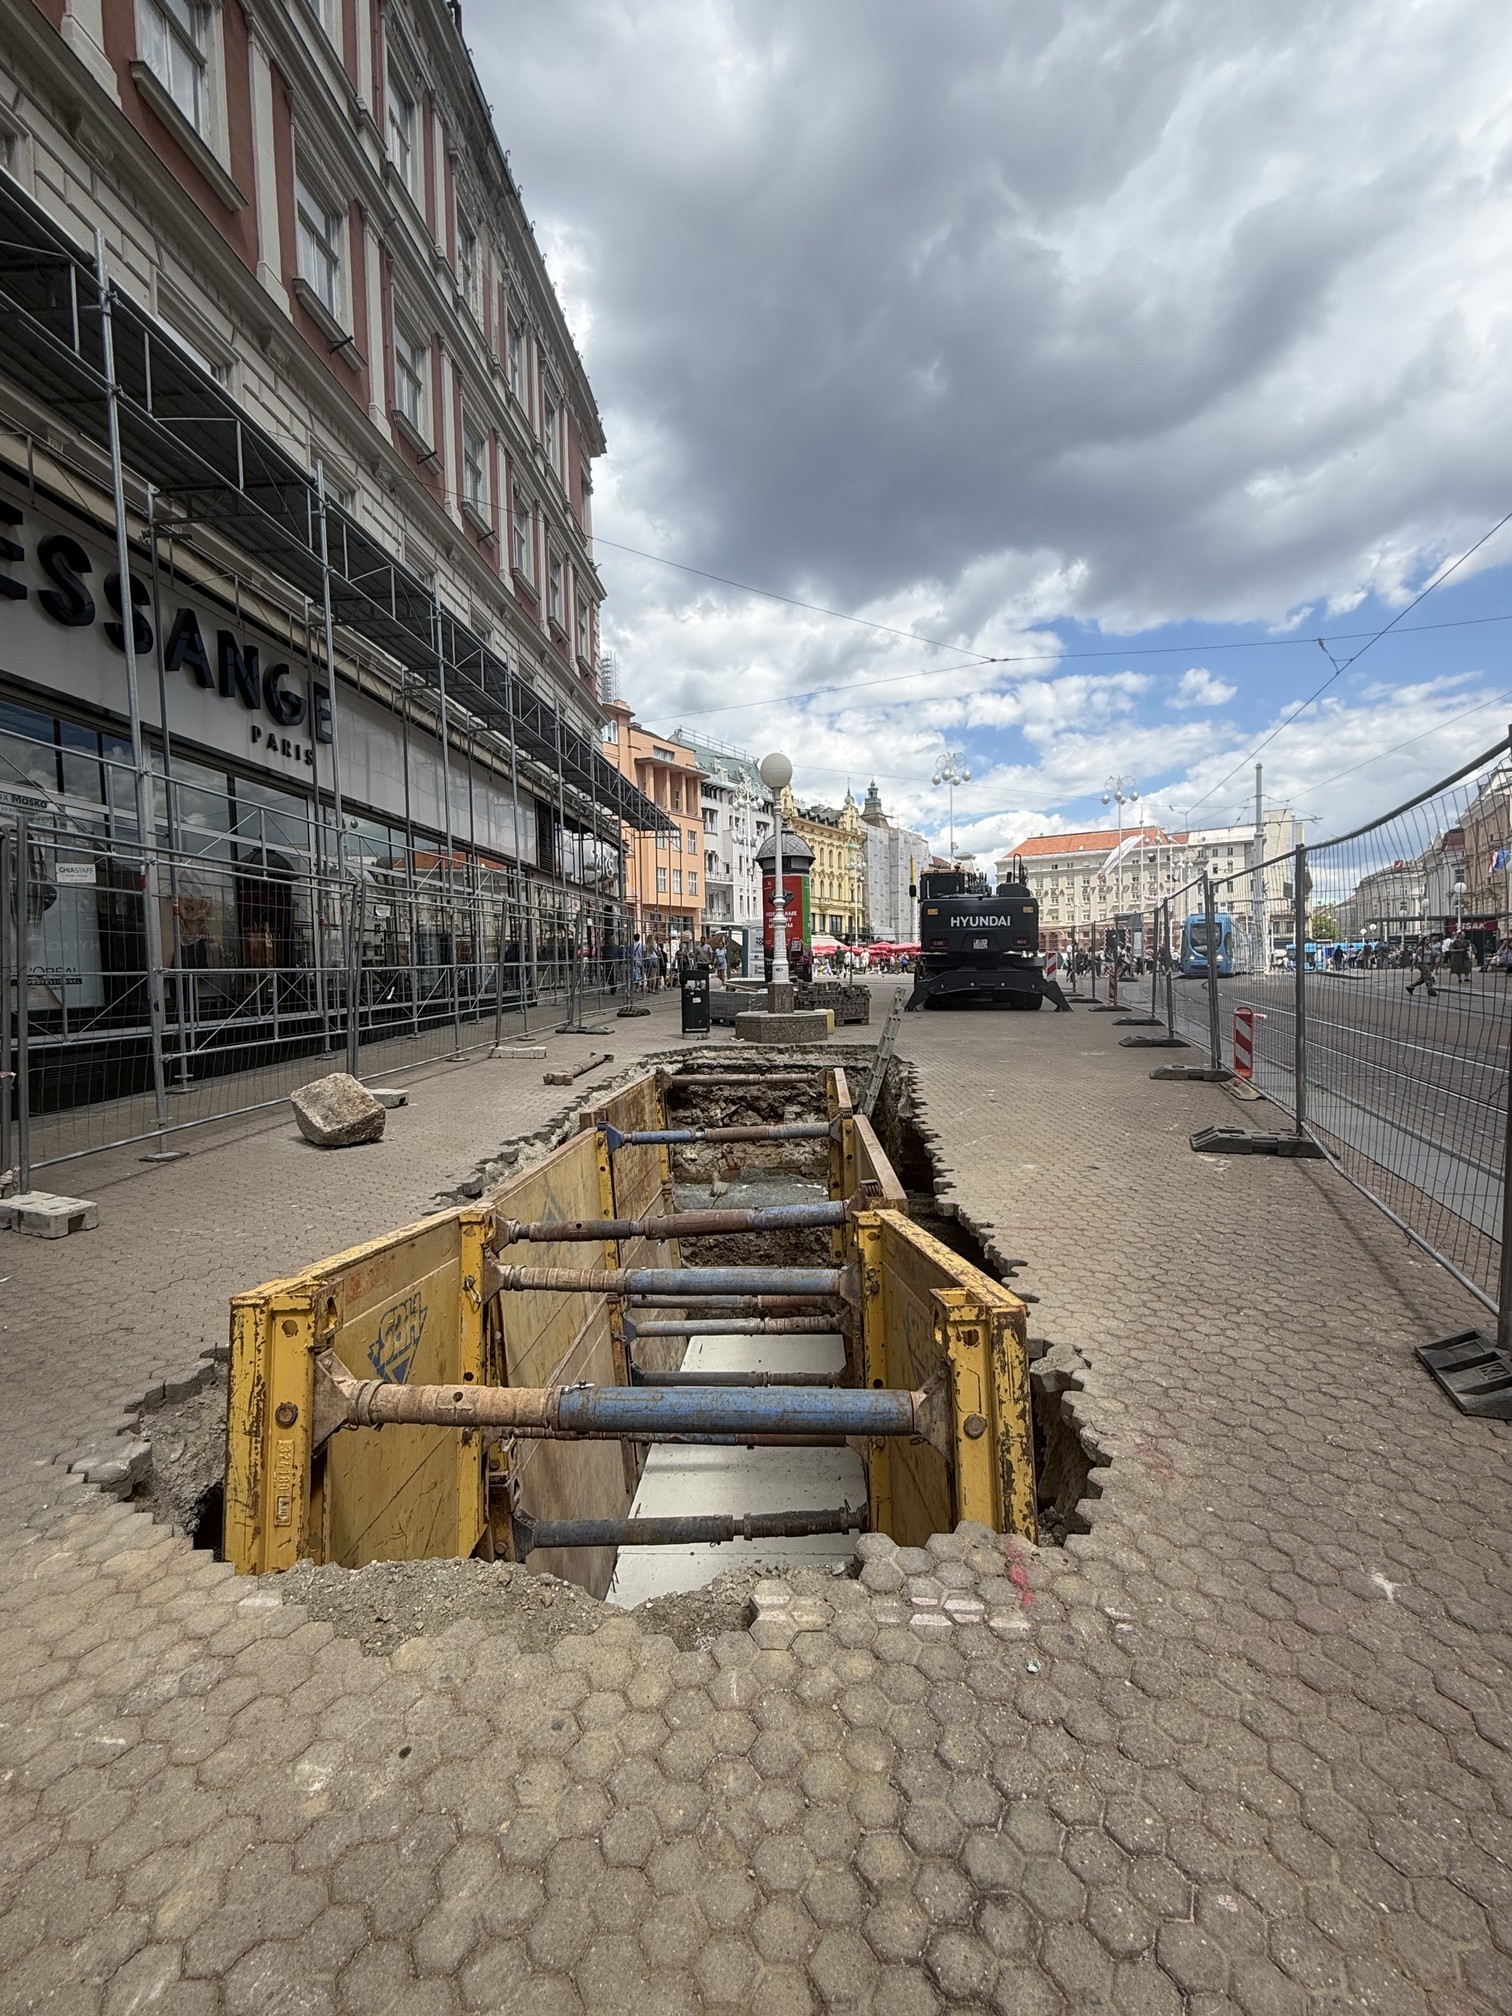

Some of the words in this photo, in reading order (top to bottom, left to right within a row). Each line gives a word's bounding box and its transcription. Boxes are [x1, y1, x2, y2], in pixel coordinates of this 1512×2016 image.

[251, 725, 314, 766] PARIS
[12, 794, 48, 809] Maska
[950, 916, 1011, 927] HYUNDAI
